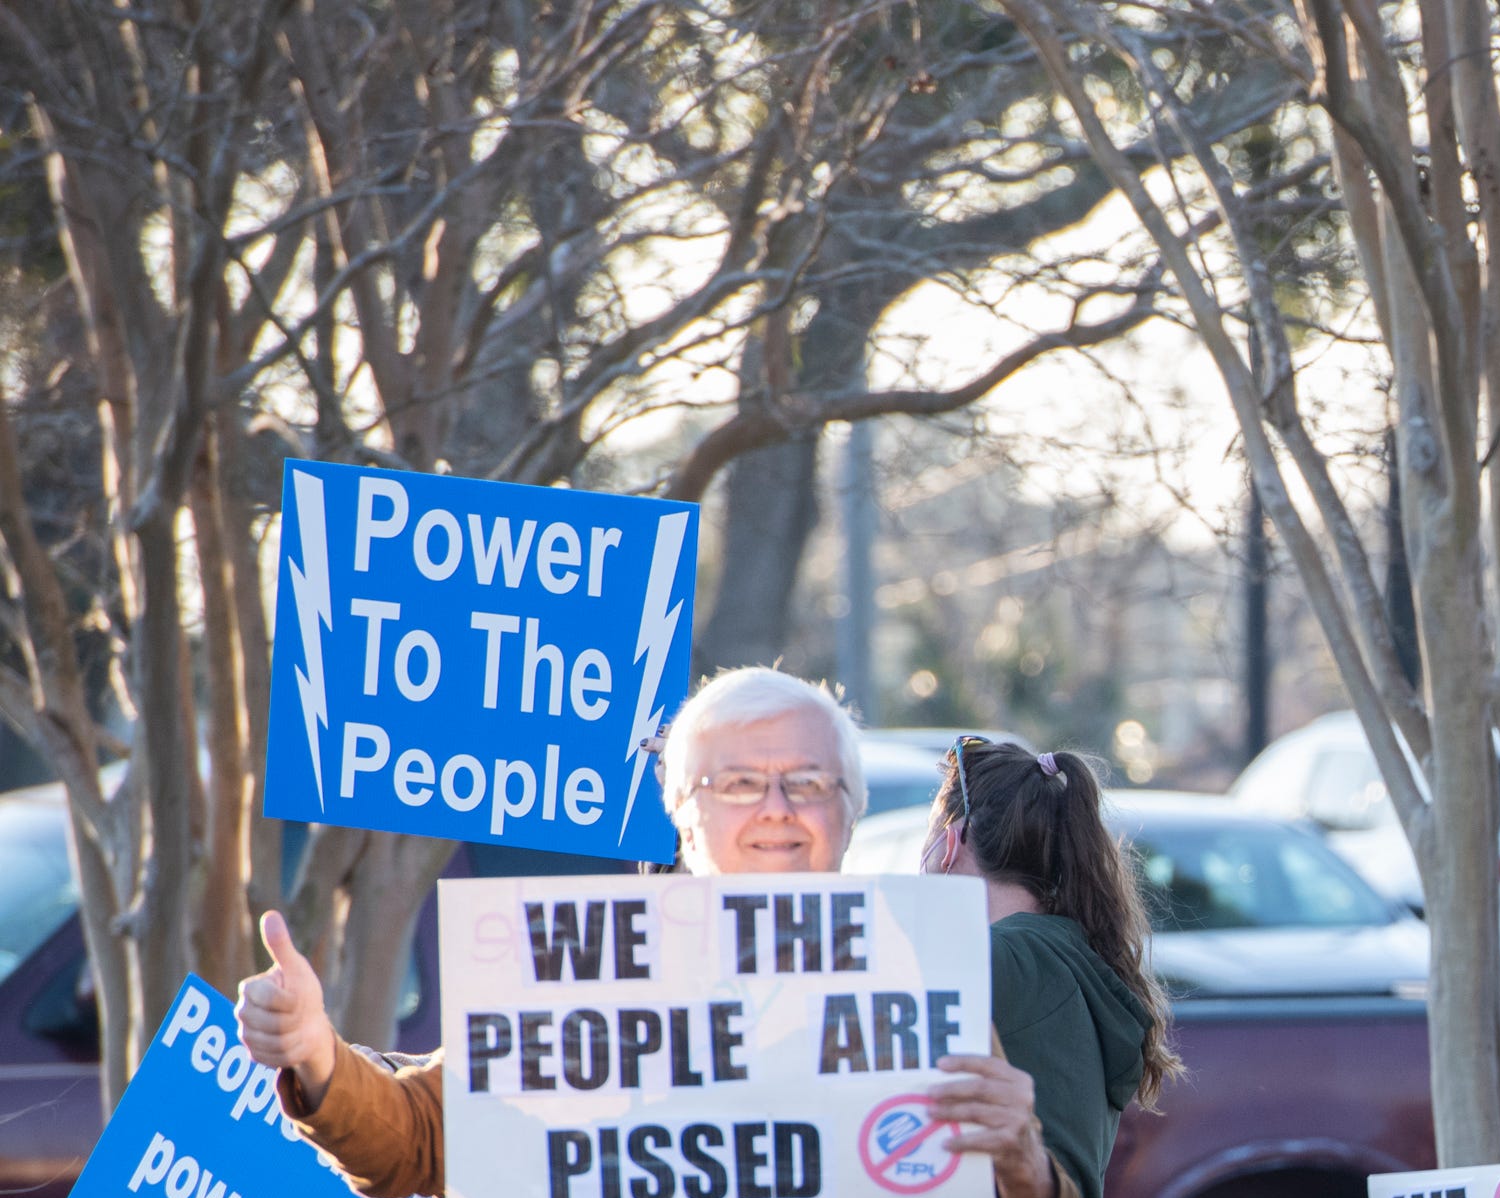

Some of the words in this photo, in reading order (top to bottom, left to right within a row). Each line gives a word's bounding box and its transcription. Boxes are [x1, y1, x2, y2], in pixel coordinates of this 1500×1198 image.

[354, 476, 622, 597] Power
[351, 598, 441, 702] To
[471, 611, 612, 721] The
[340, 722, 605, 835] People
[524, 898, 651, 982] WE
[723, 893, 868, 975] THE
[466, 1002, 748, 1093] PEOPLE
[818, 990, 961, 1077] ARE
